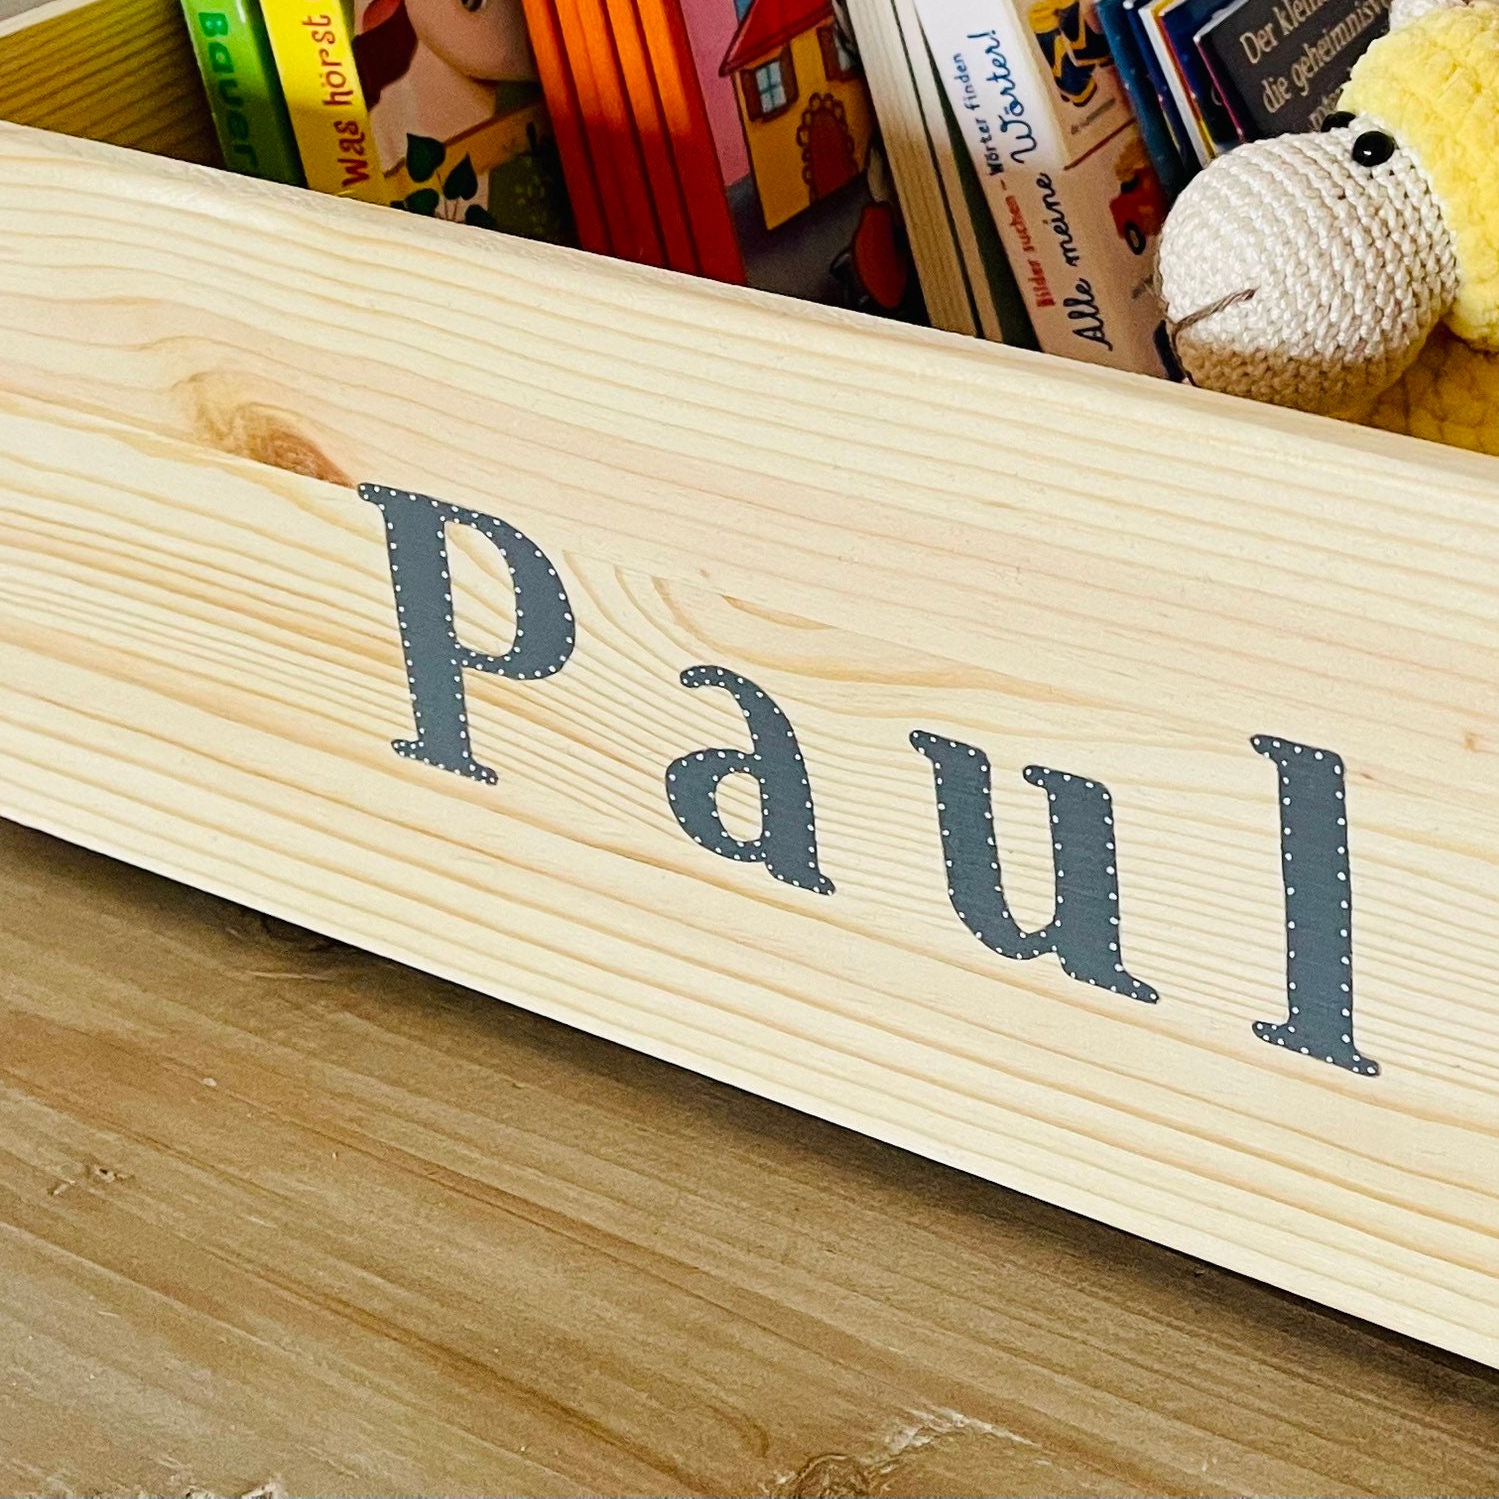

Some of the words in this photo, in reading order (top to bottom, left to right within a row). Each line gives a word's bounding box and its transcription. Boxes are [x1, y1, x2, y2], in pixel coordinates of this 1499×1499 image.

[302, 13, 355, 107] hörst
[1238, 20, 1282, 65] Der
[952, 51, 980, 114] finden
[967, 29, 1038, 165] Wörter!
[1261, 69, 1293, 115] die
[334, 119, 371, 188] Was
[974, 116, 1005, 177] Wörter
[1003, 194, 1037, 253] suchen
[1035, 171, 1081, 268] meine
[1062, 276, 1114, 352] Alle
[357, 482, 1380, 1078] Paul
